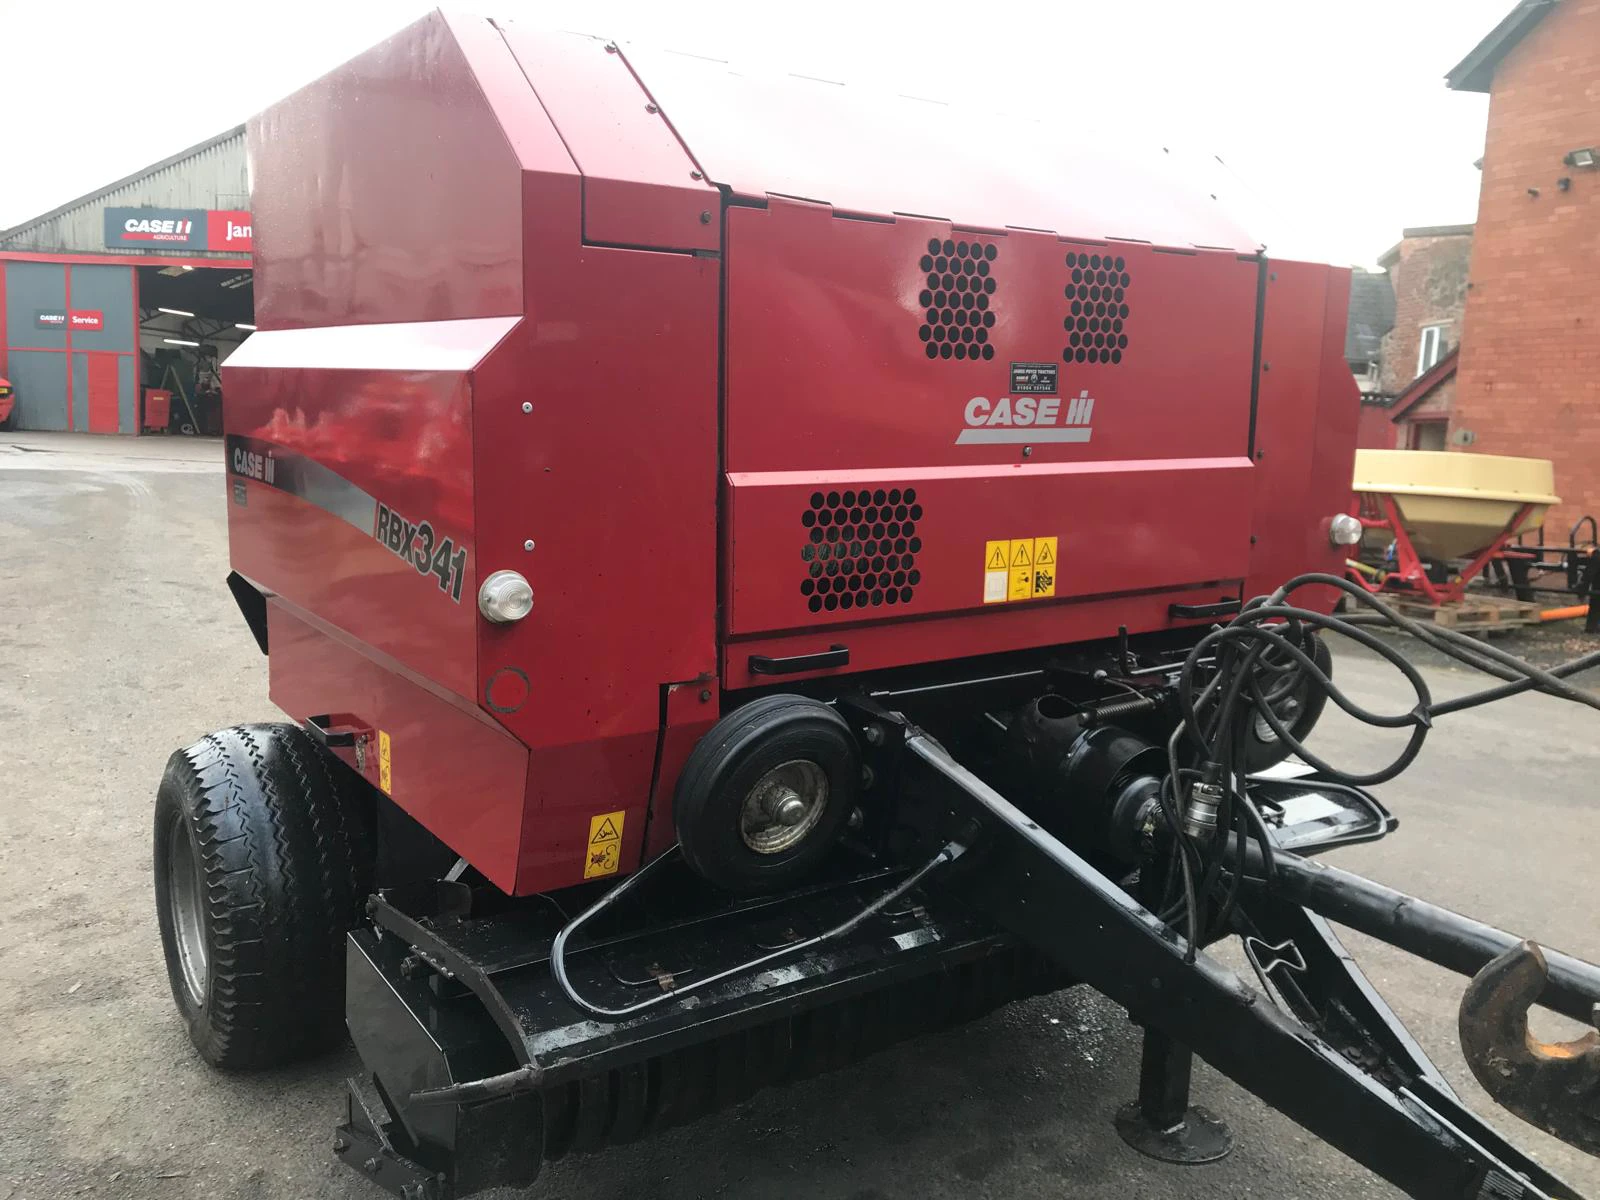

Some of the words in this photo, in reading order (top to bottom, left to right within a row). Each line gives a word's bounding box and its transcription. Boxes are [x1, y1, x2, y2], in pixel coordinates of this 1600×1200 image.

[124, 219, 175, 233] CASE
[152, 233, 187, 241] AGRICULTURE
[72, 315, 98, 324] Service
[964, 396, 1061, 427] CASE
[234, 447, 263, 480] CASE
[376, 501, 468, 605] RBX341
